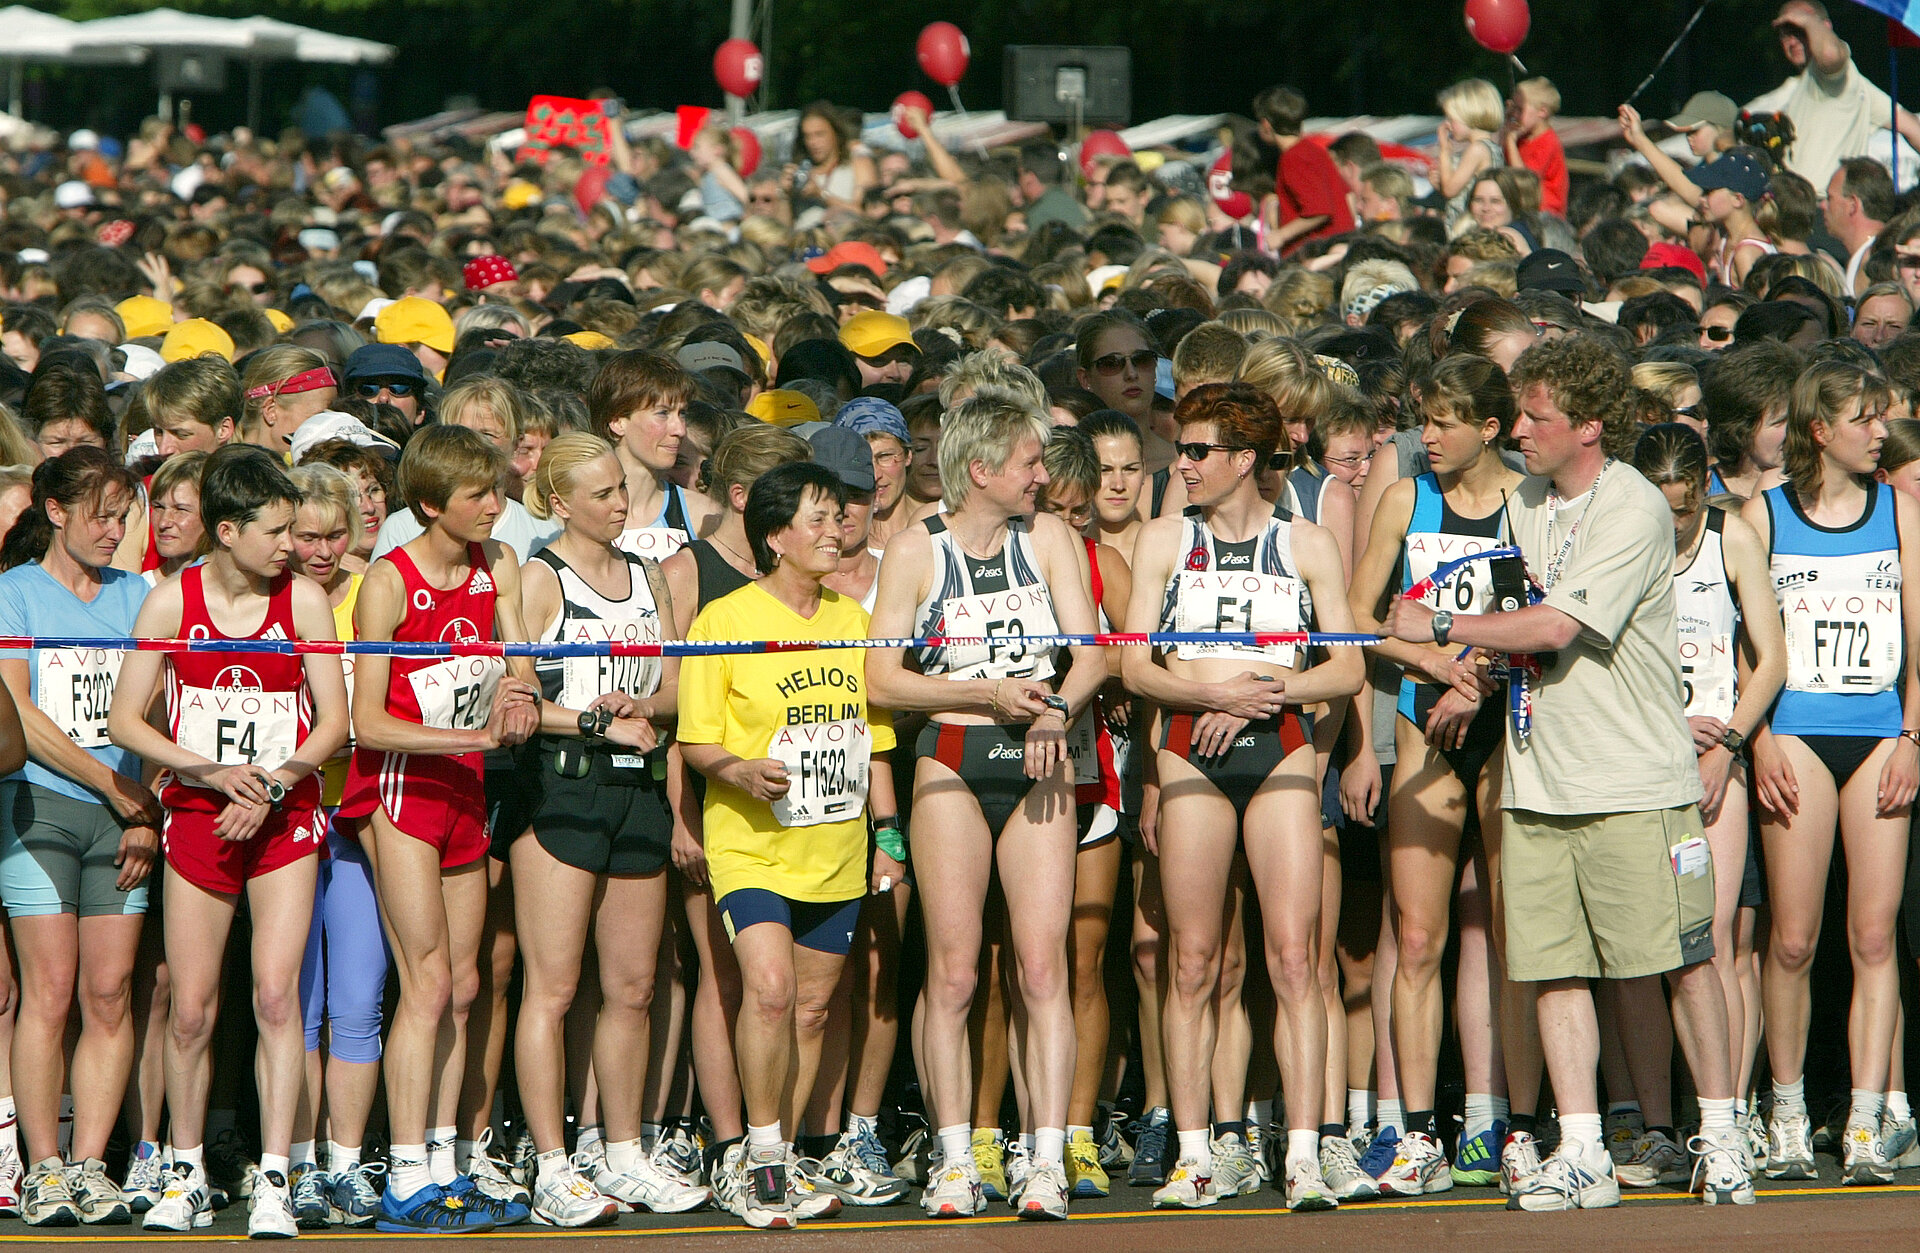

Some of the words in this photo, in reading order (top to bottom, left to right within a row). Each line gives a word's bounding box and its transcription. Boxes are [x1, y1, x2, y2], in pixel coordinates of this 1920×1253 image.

[612, 532, 684, 550] VON
[1410, 538, 1482, 556] AVO
[1190, 575, 1292, 596] AVON
[955, 590, 1043, 619] AVON
[1216, 596, 1253, 633] F1
[1794, 596, 1893, 614] AVON
[576, 623, 657, 641] AVON
[1676, 614, 1710, 626] -Schwarz
[1680, 635, 1726, 659] ON
[1814, 620, 1871, 667] F772
[425, 655, 502, 690] AVON
[776, 667, 858, 699] HELIOS
[189, 693, 290, 714] AVON
[451, 683, 481, 729] F2
[786, 703, 859, 726] BERLIN
[216, 718, 258, 765] F4
[778, 722, 866, 746] AVON
[801, 748, 846, 799] F1523
[847, 779, 857, 793] M
